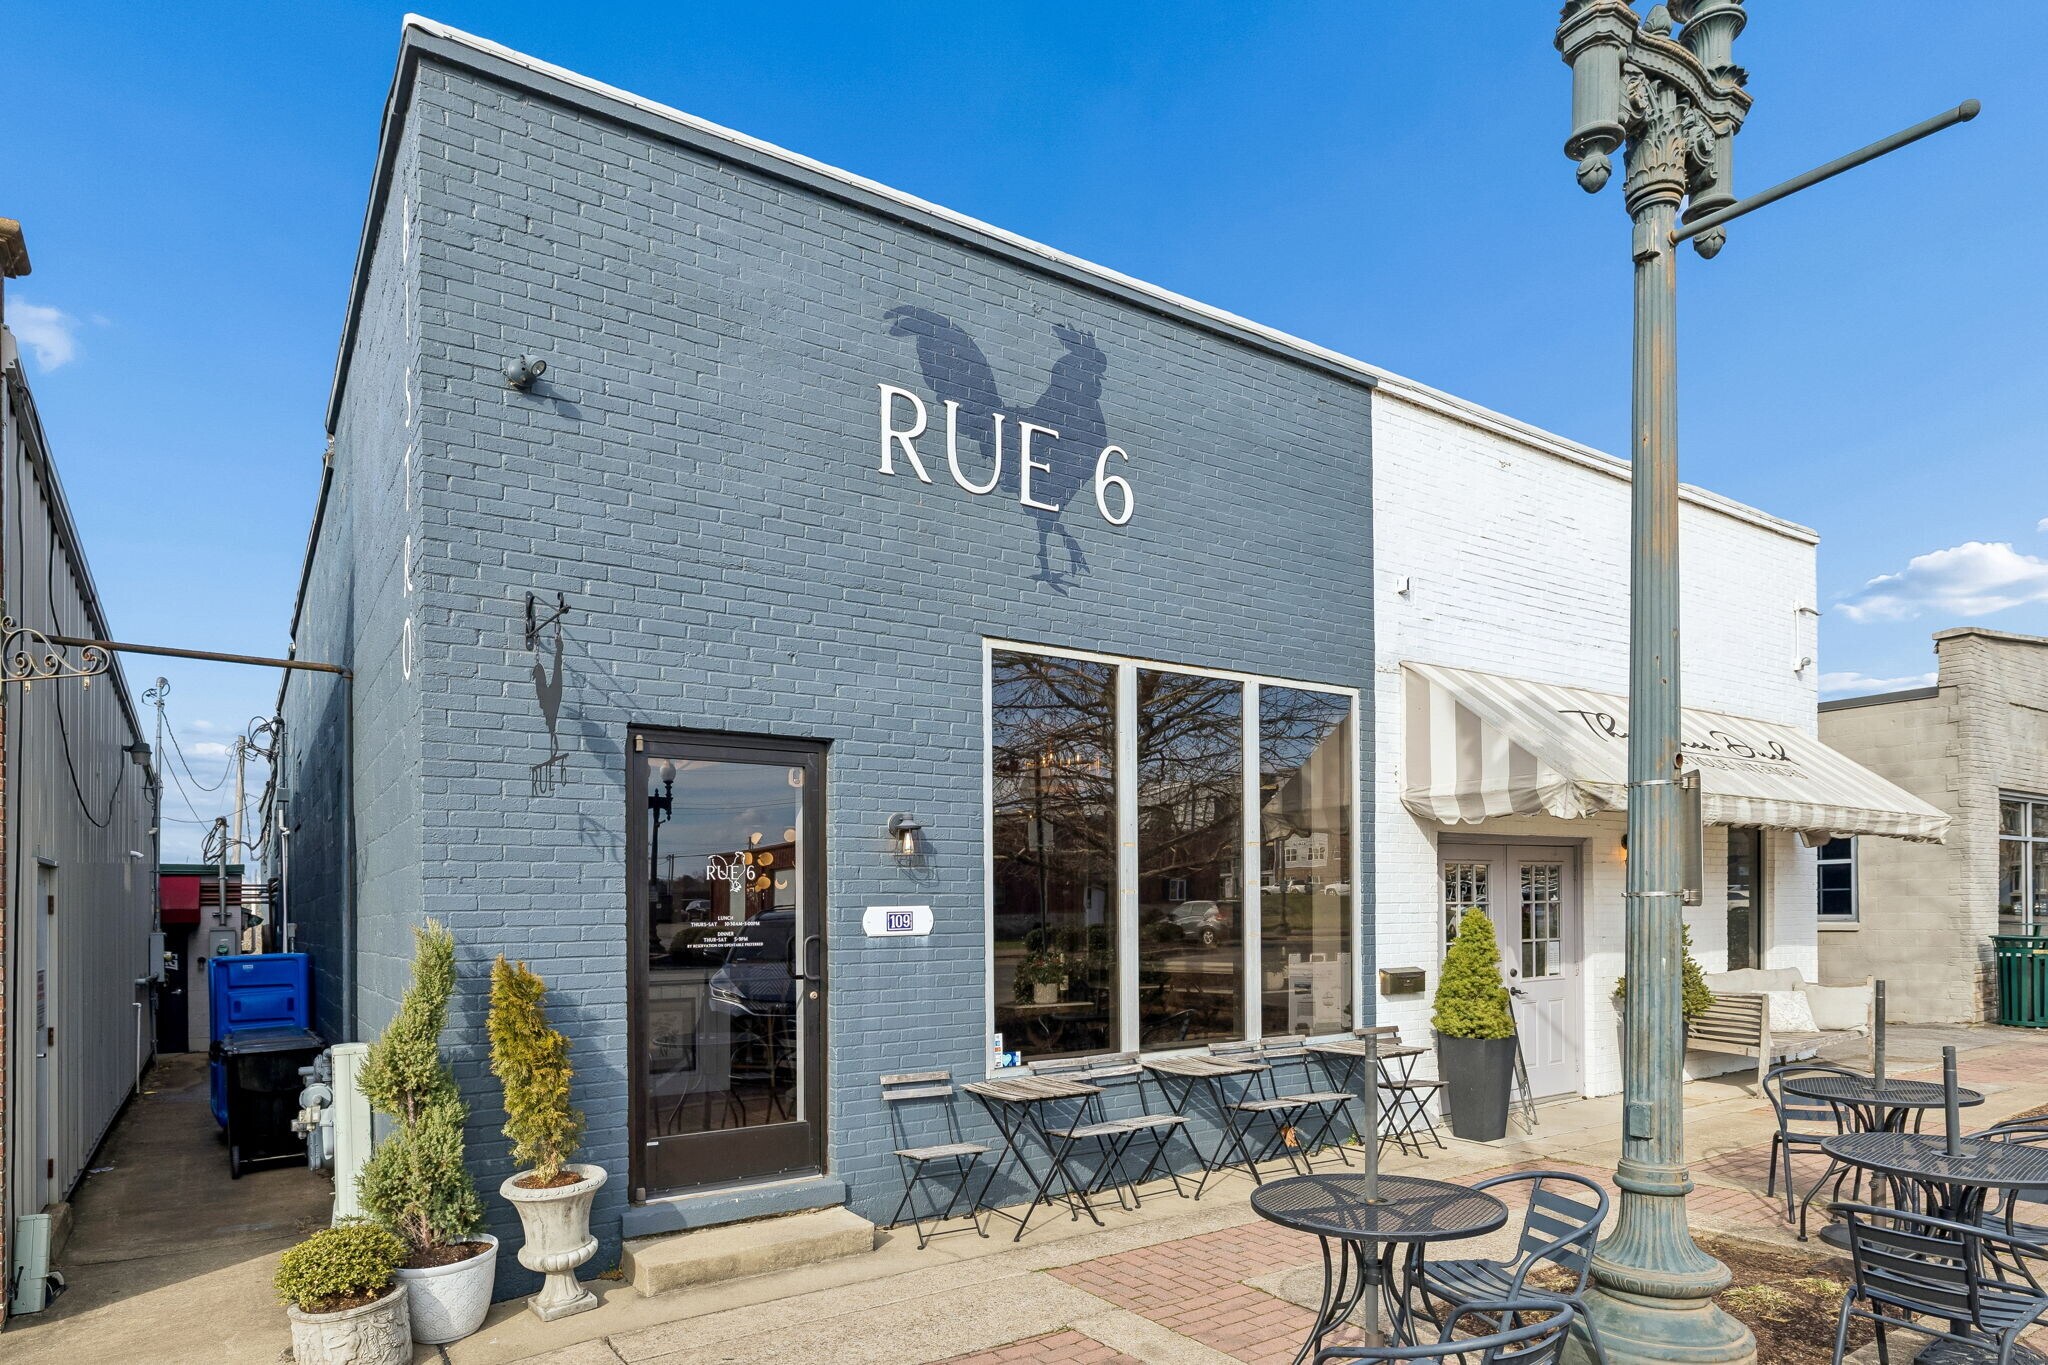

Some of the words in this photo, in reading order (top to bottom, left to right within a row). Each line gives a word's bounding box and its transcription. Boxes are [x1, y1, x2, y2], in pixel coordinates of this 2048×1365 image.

[876, 382, 1061, 512] RUE
[1094, 444, 1135, 526] 6
[531, 761, 556, 797] RUE
[560, 757, 567, 787] 6
[706, 865, 739, 881] RUE
[746, 865, 756, 880] 6
[889, 914, 911, 928] 109
